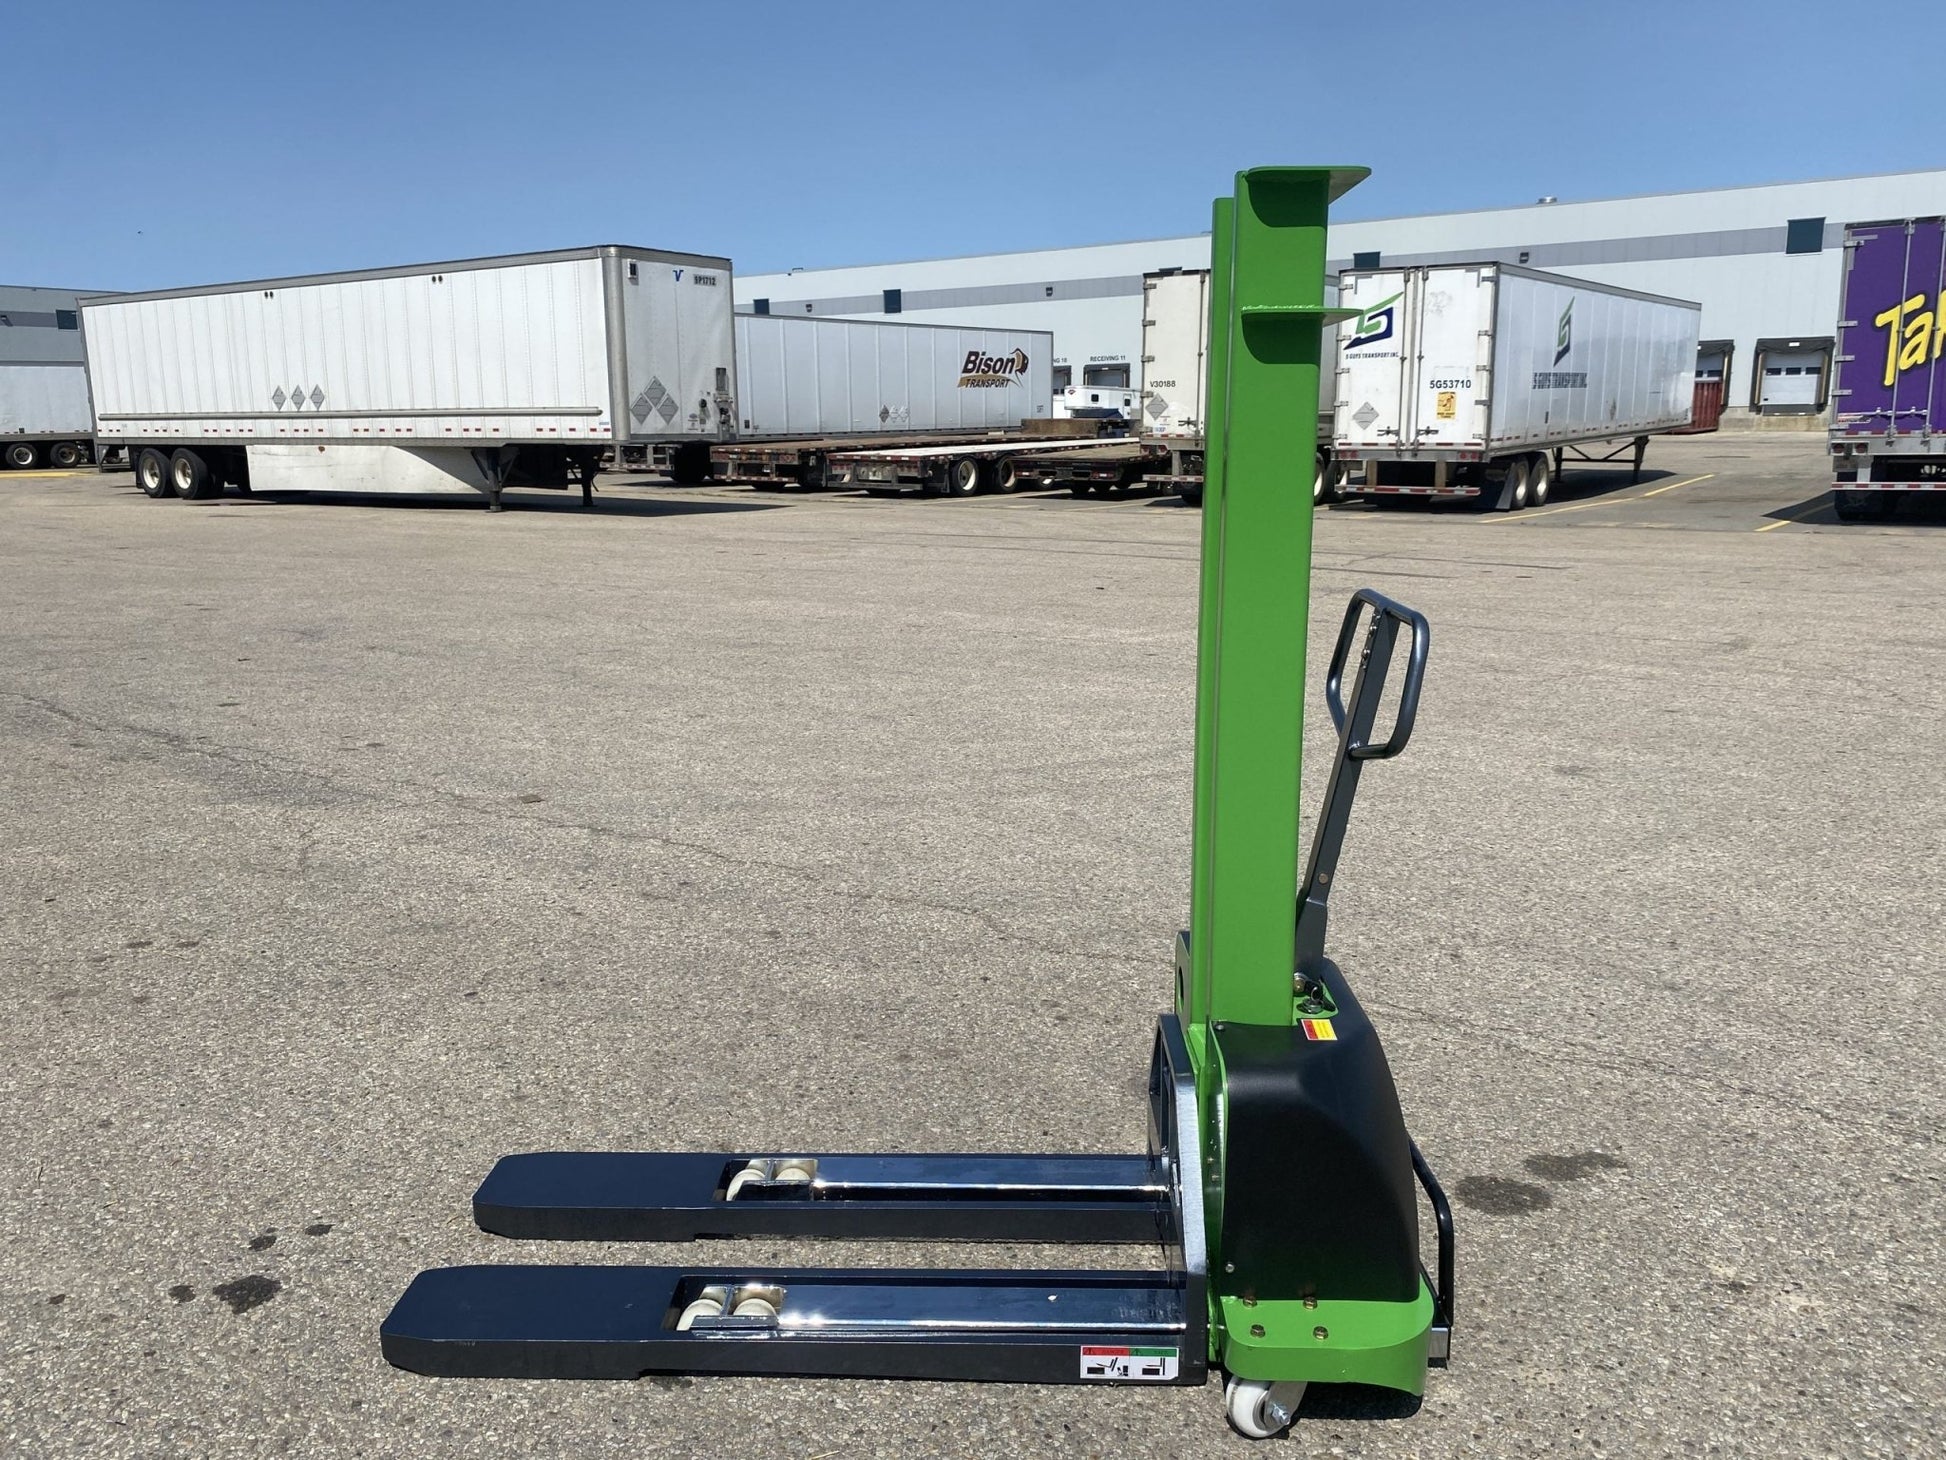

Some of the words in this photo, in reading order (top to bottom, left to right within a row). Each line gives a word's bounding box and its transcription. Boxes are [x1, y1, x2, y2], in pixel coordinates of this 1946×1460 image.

[961, 350, 1016, 374] Bison
[965, 379, 1010, 388] TRANSPORT
[1150, 380, 1176, 388] V30188
[1429, 380, 1472, 389] 5G53710
